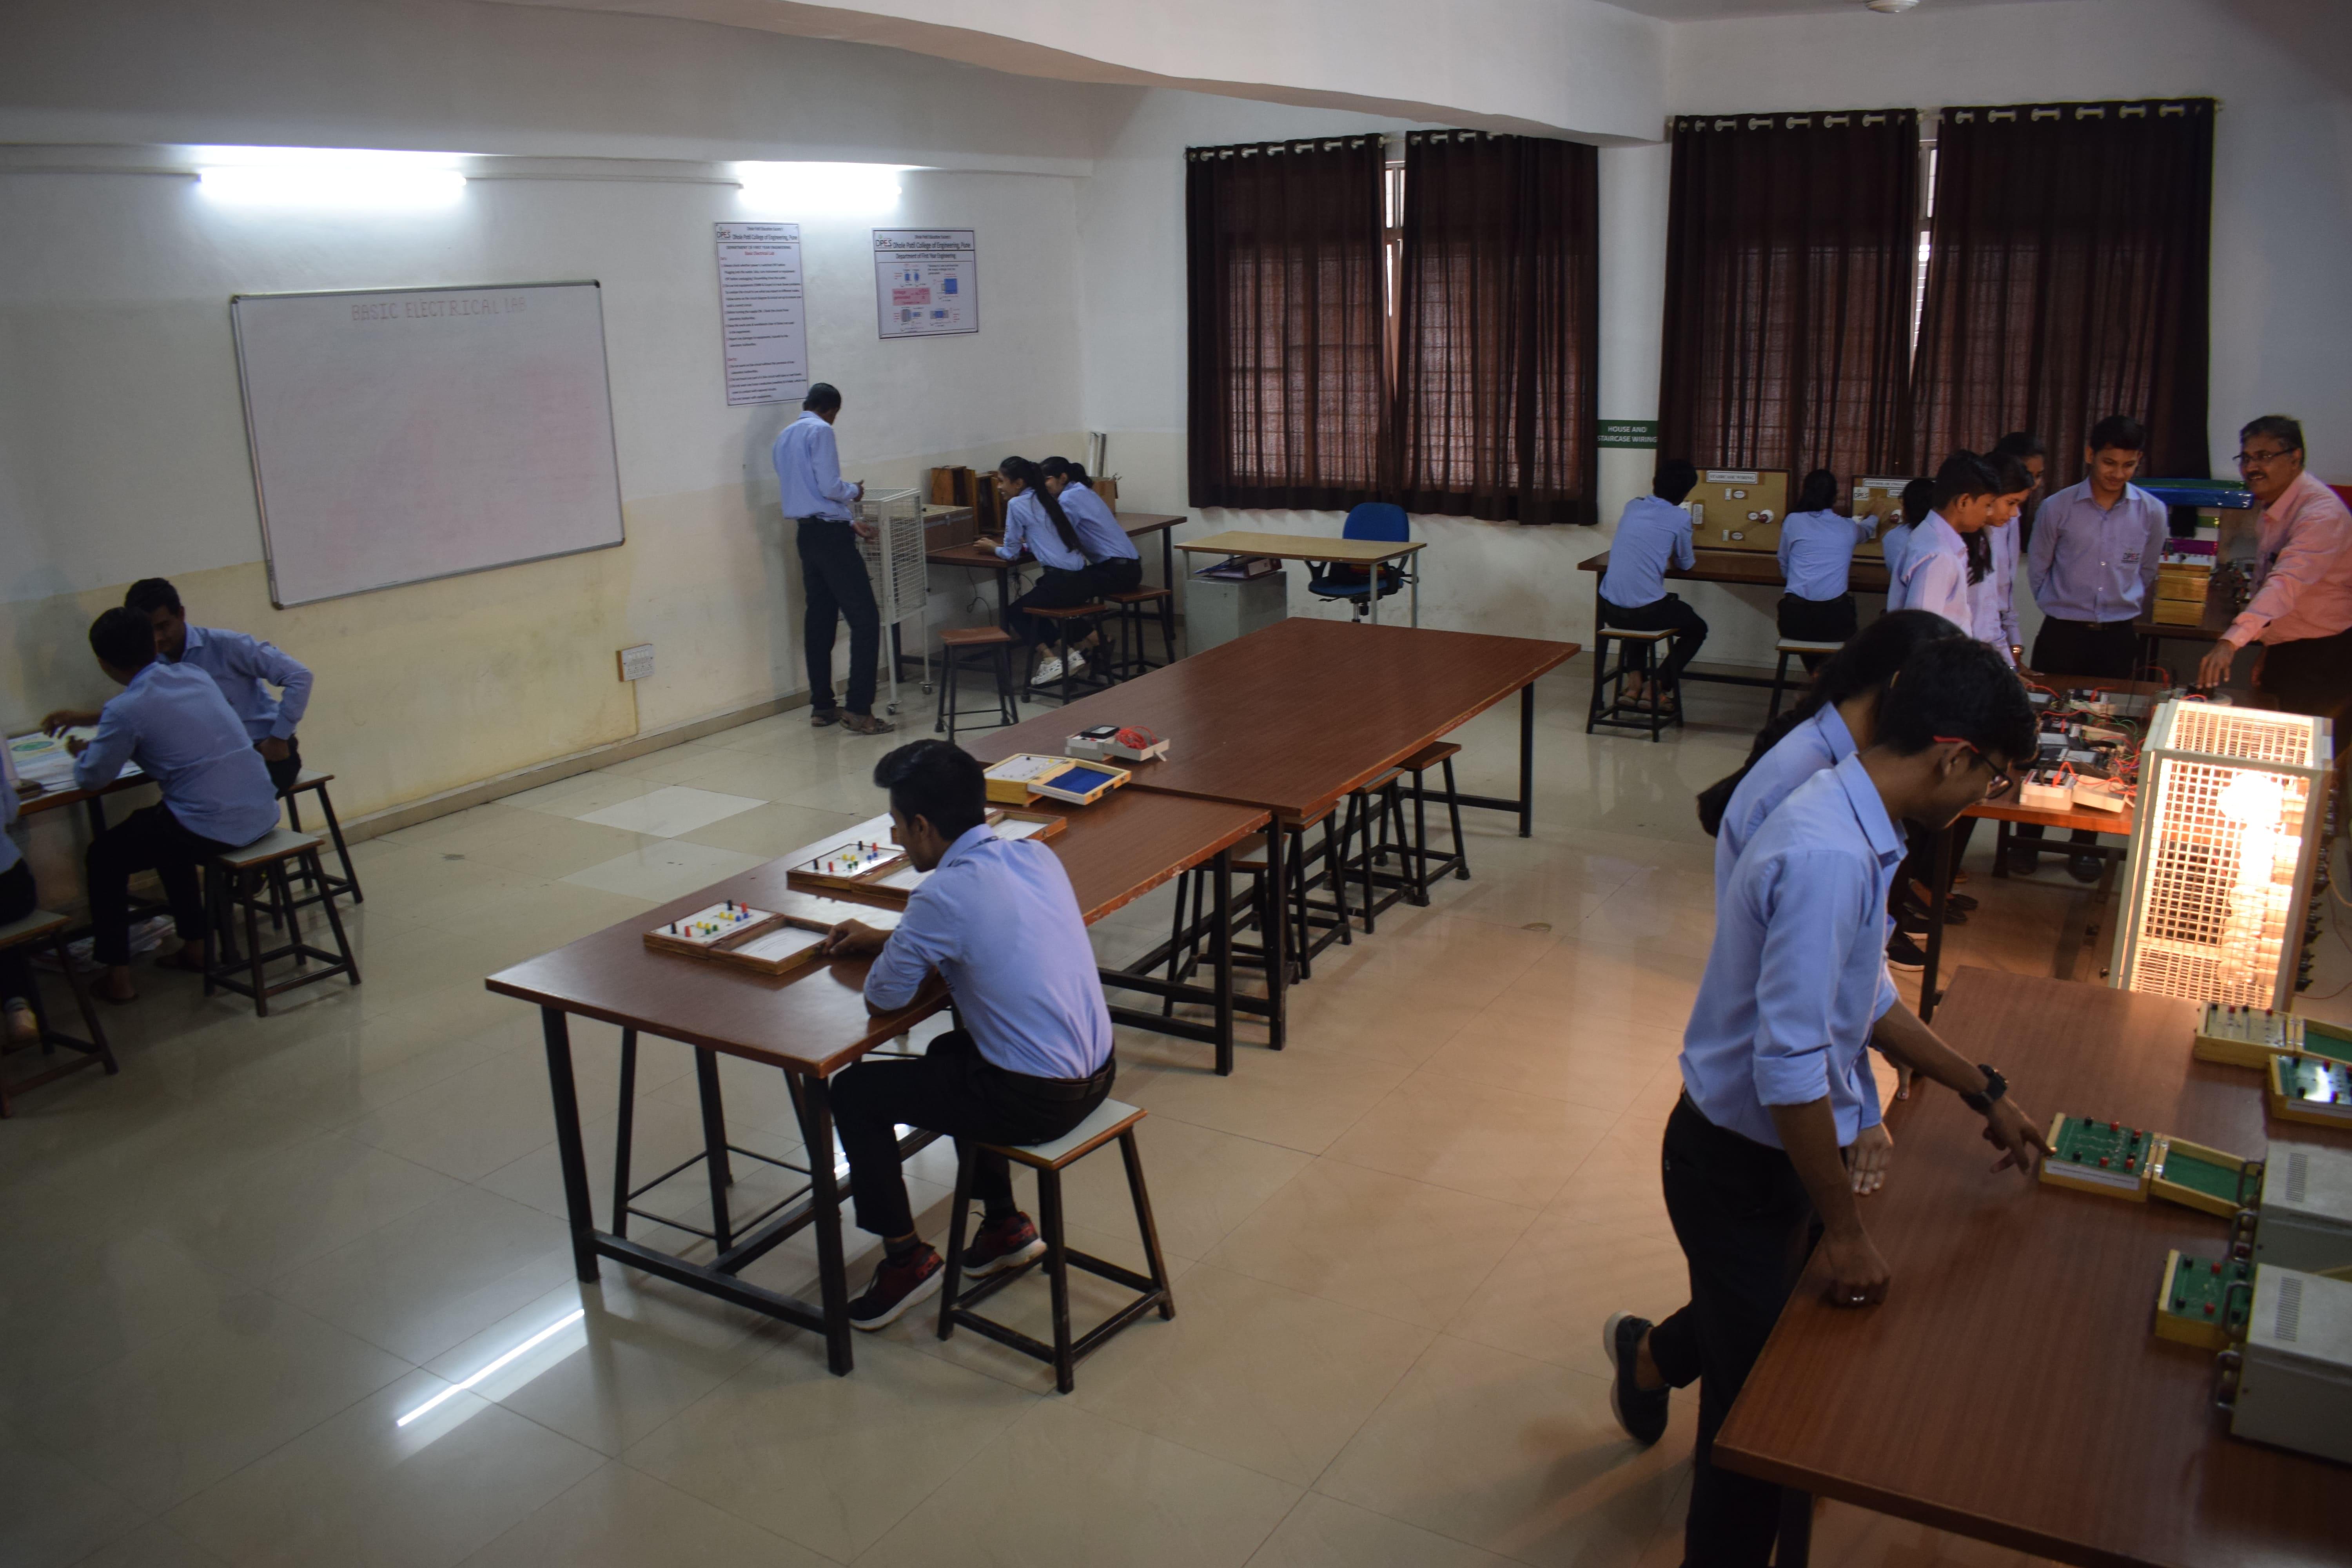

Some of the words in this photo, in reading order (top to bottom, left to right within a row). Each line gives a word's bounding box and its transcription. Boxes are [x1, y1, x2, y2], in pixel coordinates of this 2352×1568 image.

[916, 241, 931, 250] College
[352, 303, 398, 320] BASIC
[405, 299, 500, 318] ELECTRICAL
[505, 297, 526, 313] LAB
